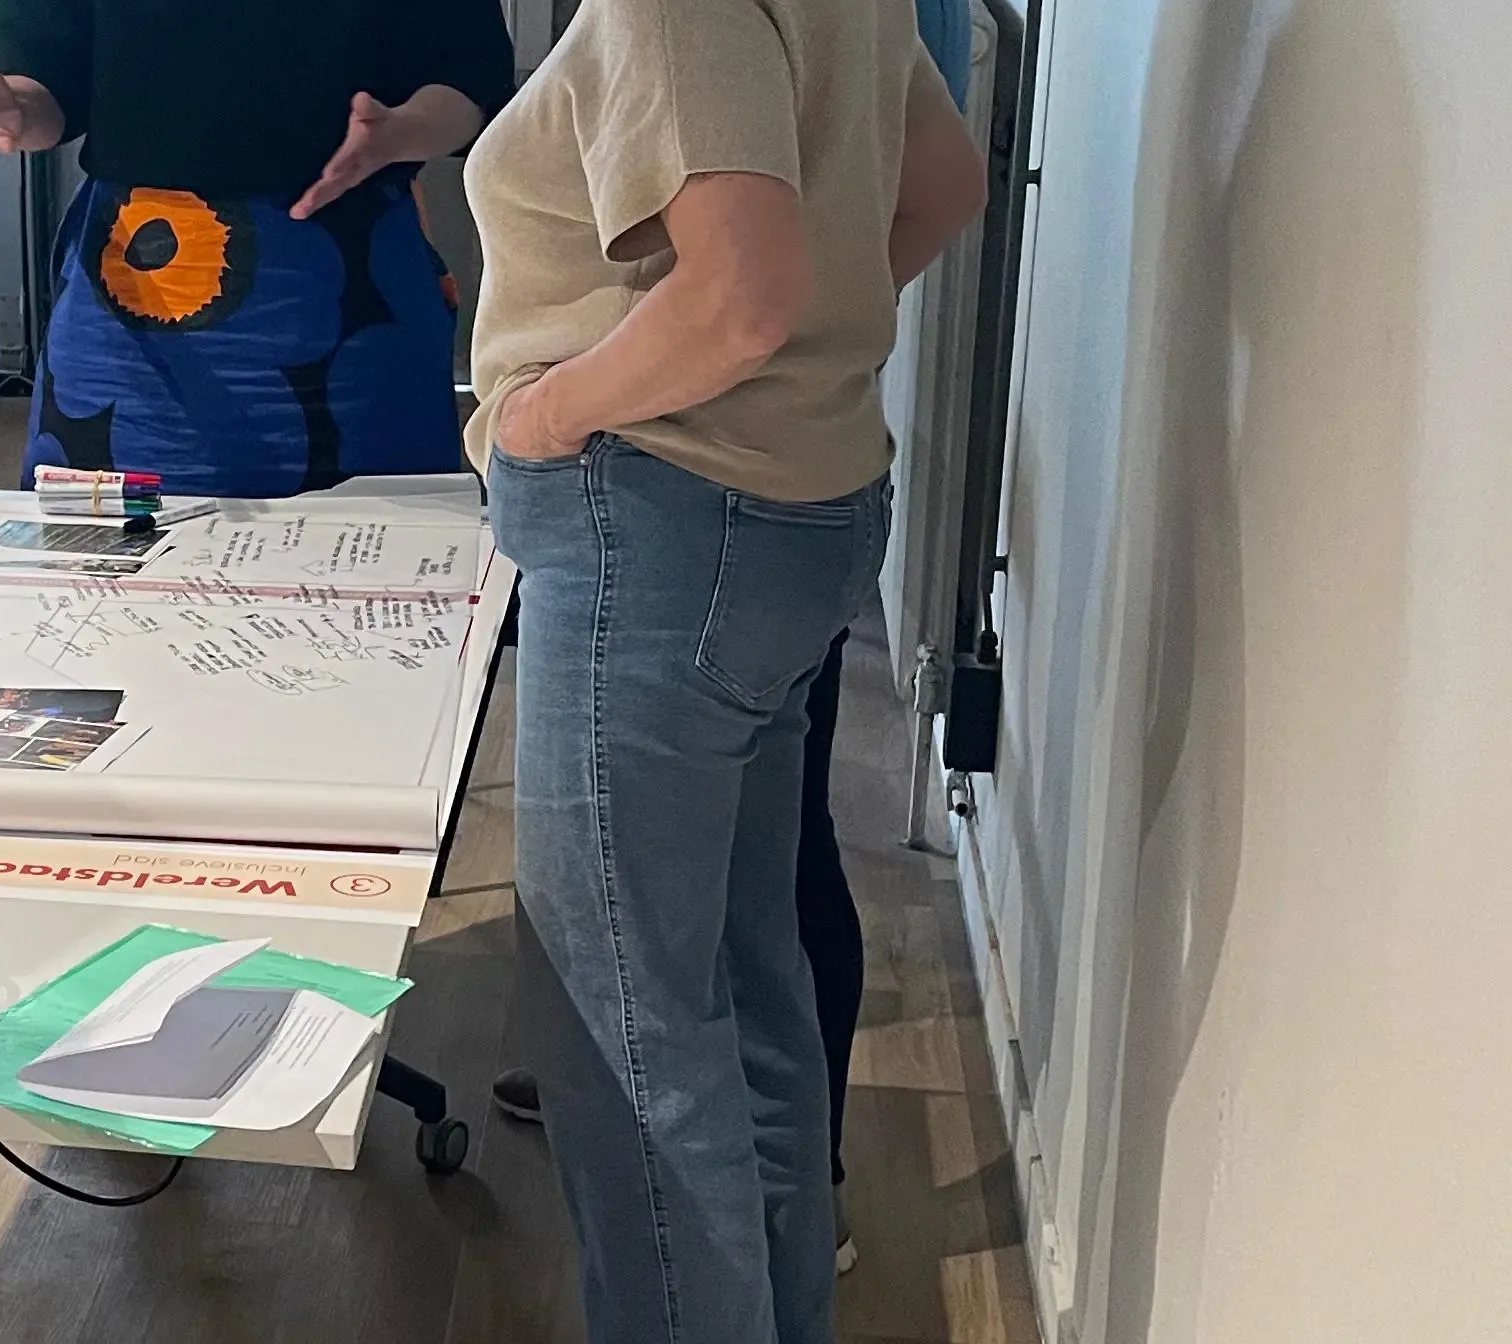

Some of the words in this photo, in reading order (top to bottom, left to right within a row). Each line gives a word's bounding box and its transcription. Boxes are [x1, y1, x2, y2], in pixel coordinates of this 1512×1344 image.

[112, 854, 171, 866] stad
[179, 858, 309, 877] Inclusieve
[349, 877, 375, 893] 3
